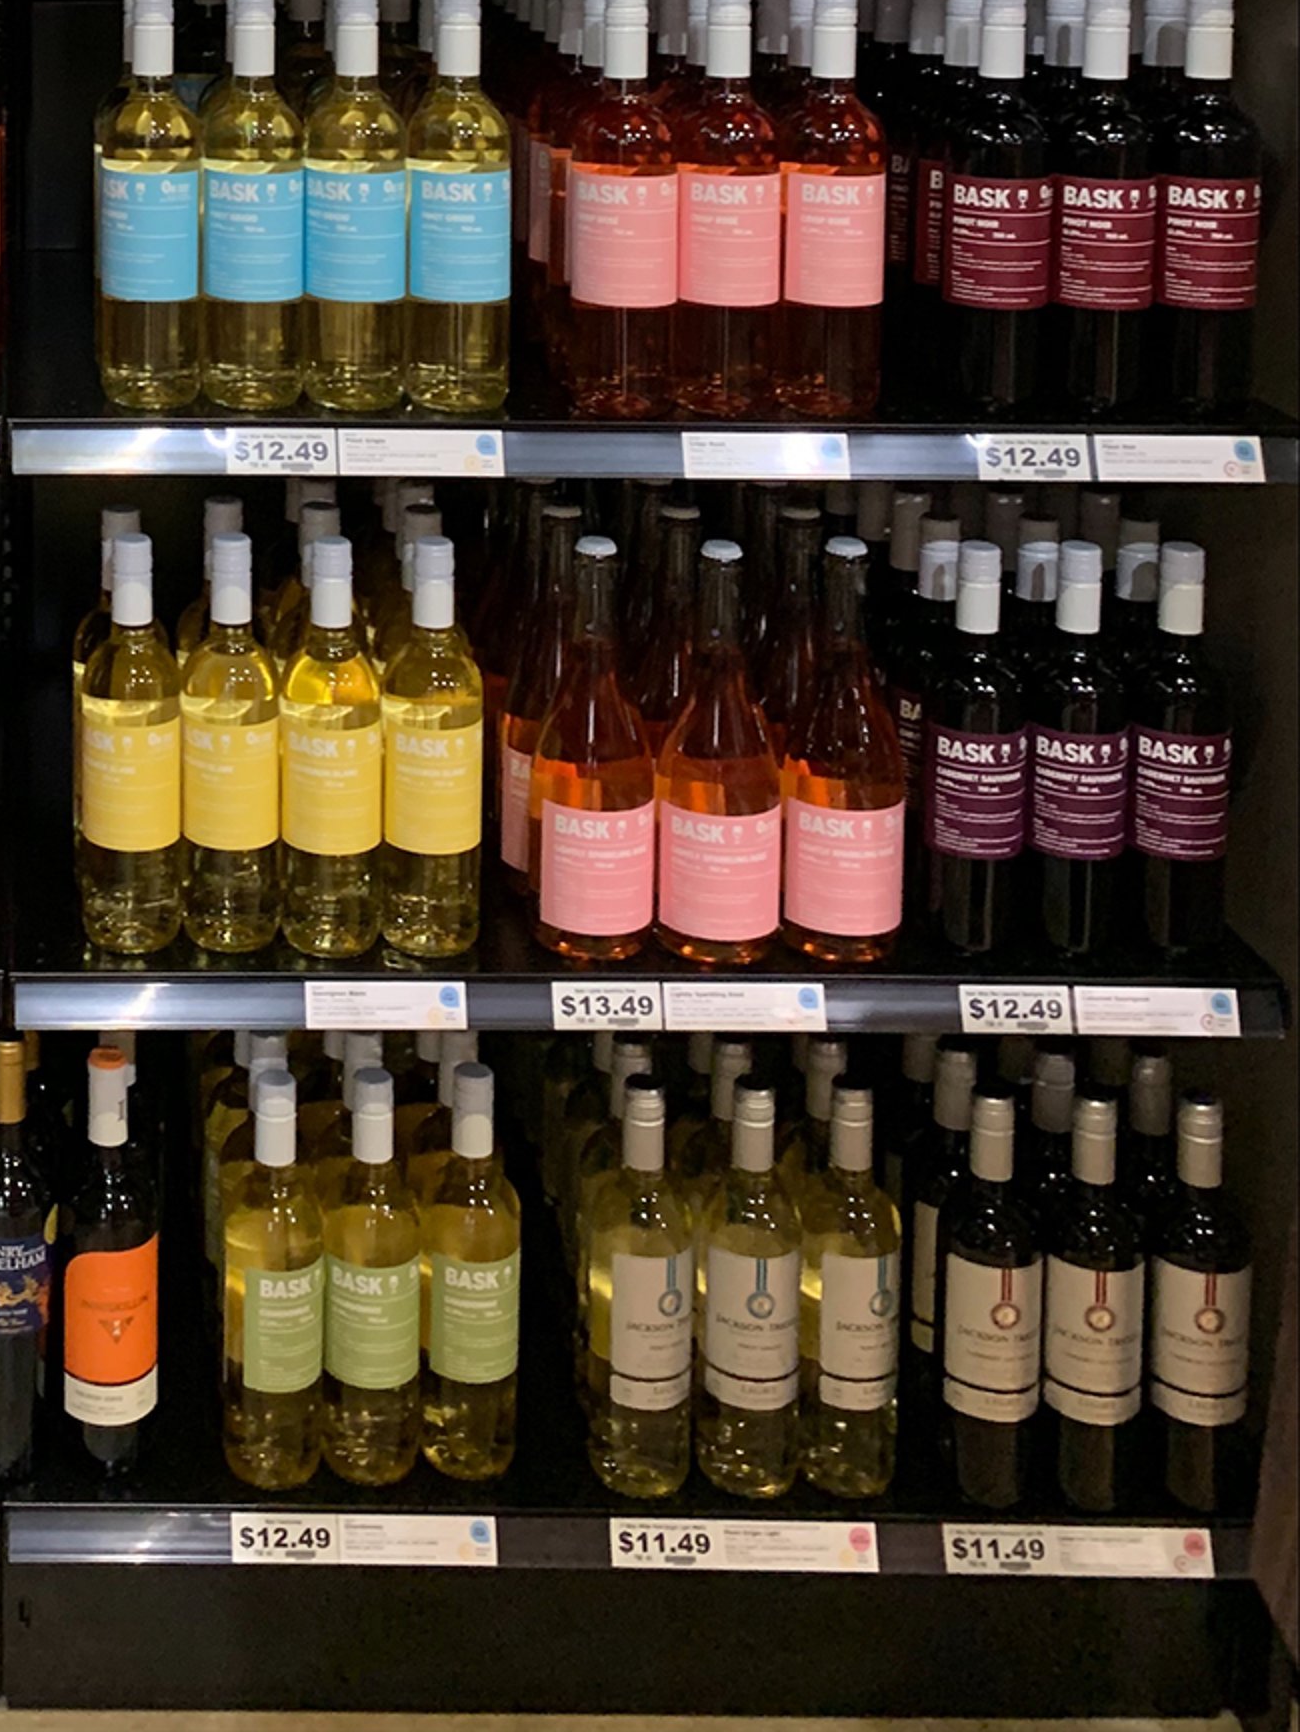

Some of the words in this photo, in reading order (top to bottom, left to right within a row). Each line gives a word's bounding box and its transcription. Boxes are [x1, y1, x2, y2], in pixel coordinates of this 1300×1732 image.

[209, 179, 260, 202] BASK
[307, 179, 352, 202] BASK
[422, 180, 477, 203] BASK
[577, 182, 629, 205] BASK
[691, 182, 748, 205] BASK
[802, 182, 860, 205] BASK
[953, 183, 1011, 209] BASK
[1063, 183, 1124, 209] BASK
[1167, 184, 1229, 209] BASK
[235, 440, 329, 461] $12.49
[985, 446, 1081, 468] $12.49
[287, 732, 339, 757] BASK
[395, 734, 449, 757] BASK
[937, 735, 995, 764] BASK
[1035, 735, 1095, 764] BASK
[1138, 735, 1198, 765] BASK
[555, 814, 609, 839] BASK
[670, 814, 724, 844] BASK
[799, 812, 855, 839] BASK
[560, 995, 654, 1017] $13.49
[969, 999, 1063, 1020] $12.49
[259, 1275, 312, 1299] BASK
[331, 1265, 383, 1296] BASK
[445, 1266, 499, 1291] BASK
[716, 1312, 764, 1333] JACKSON
[239, 1527, 331, 1549] $12.49
[618, 1531, 711, 1554] $11.49
[952, 1538, 1045, 1560] $11.49
